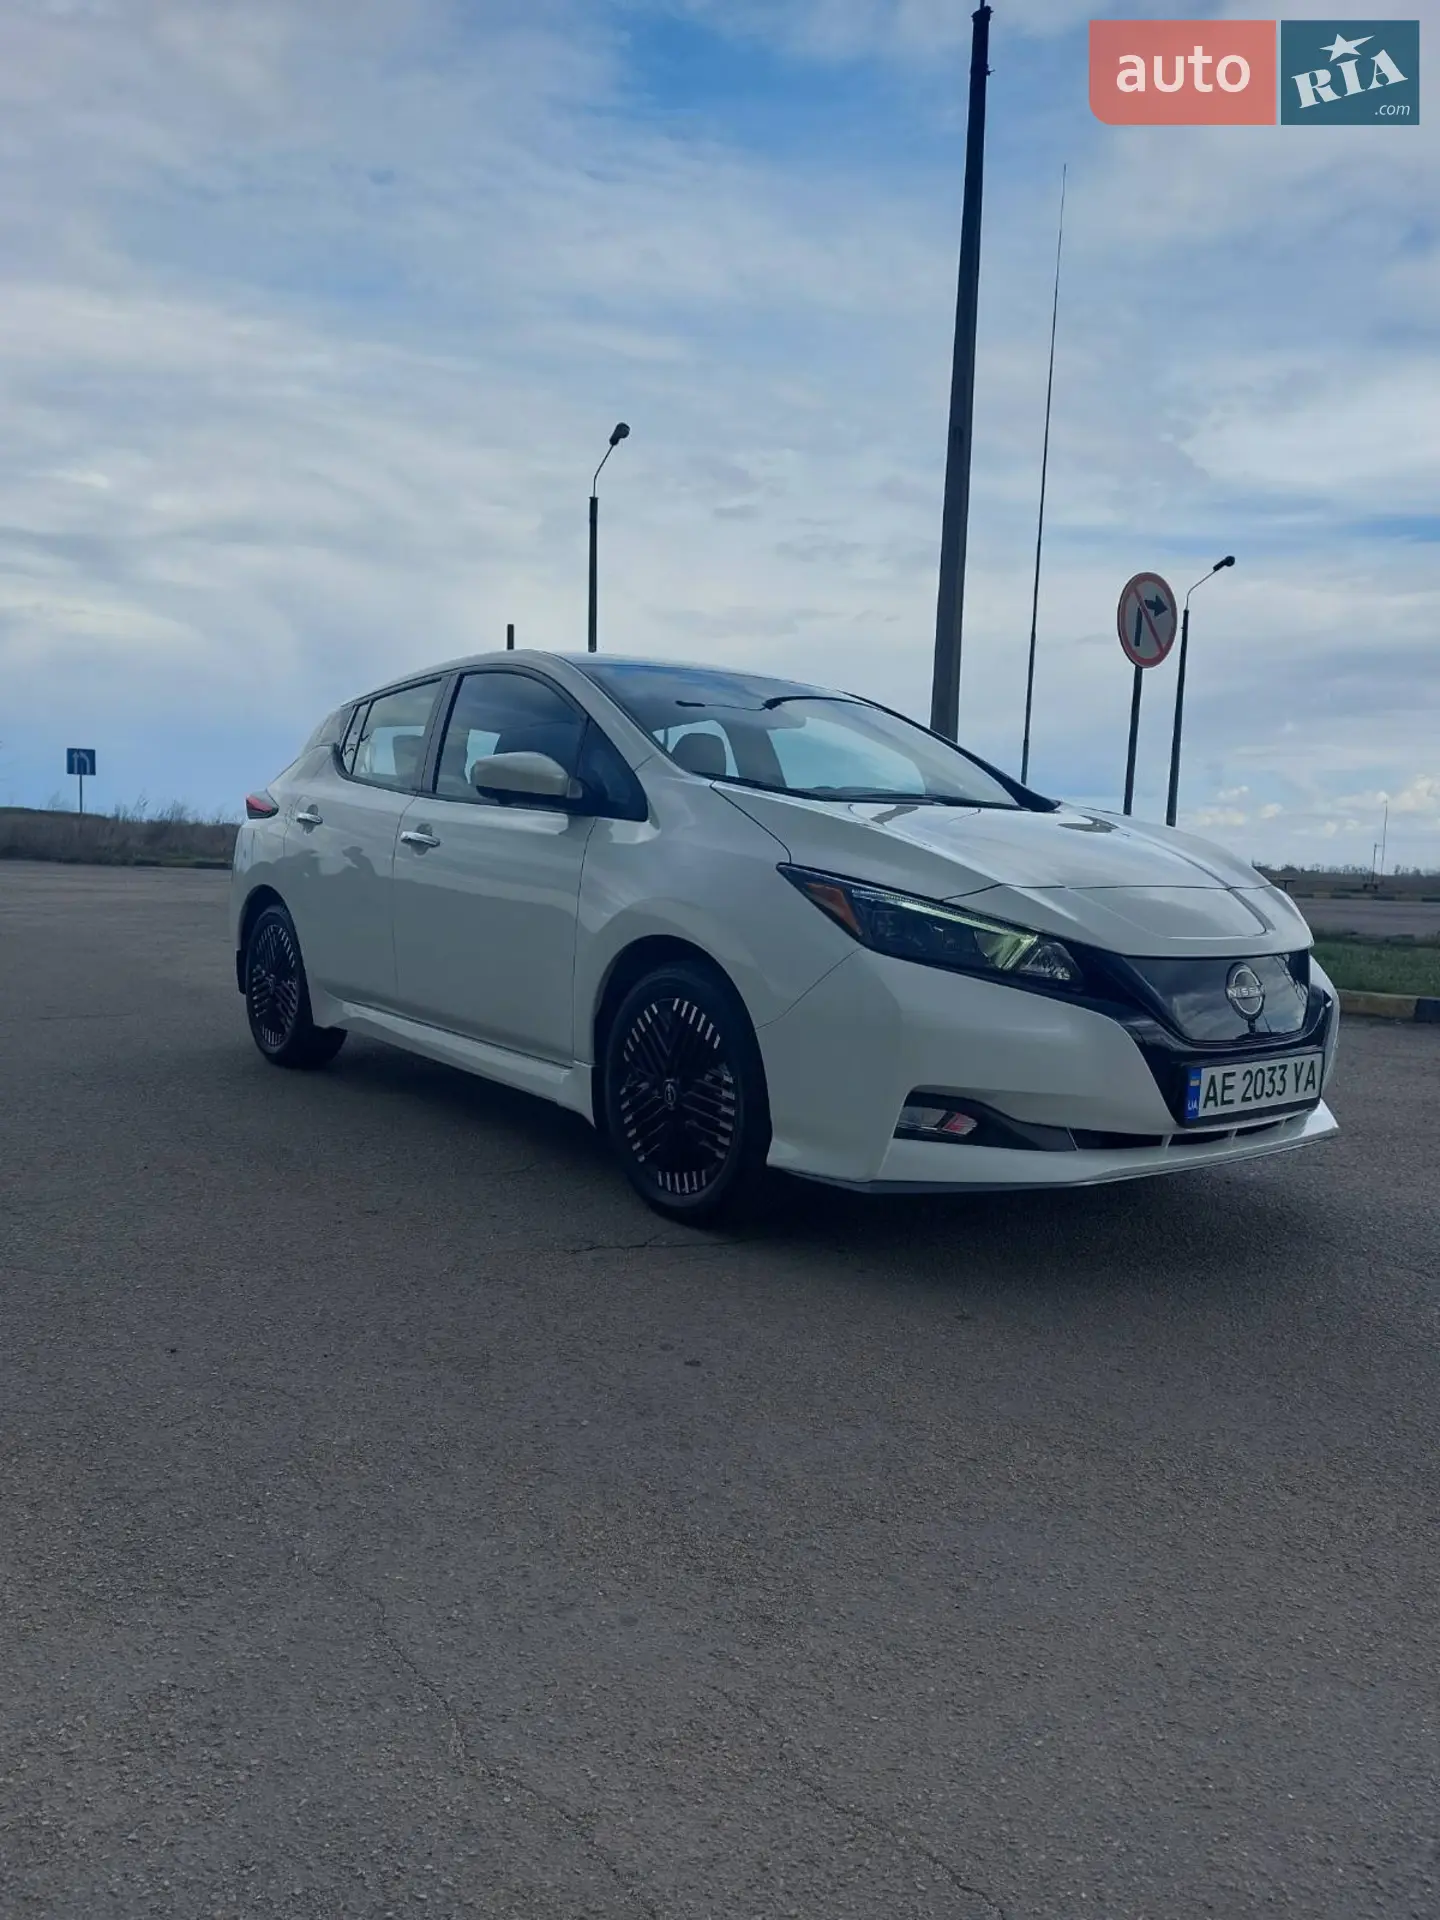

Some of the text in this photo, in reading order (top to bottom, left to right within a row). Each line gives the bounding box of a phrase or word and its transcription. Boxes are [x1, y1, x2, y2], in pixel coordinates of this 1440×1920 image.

[1203, 1060, 1316, 1109] AE 2033 YA
